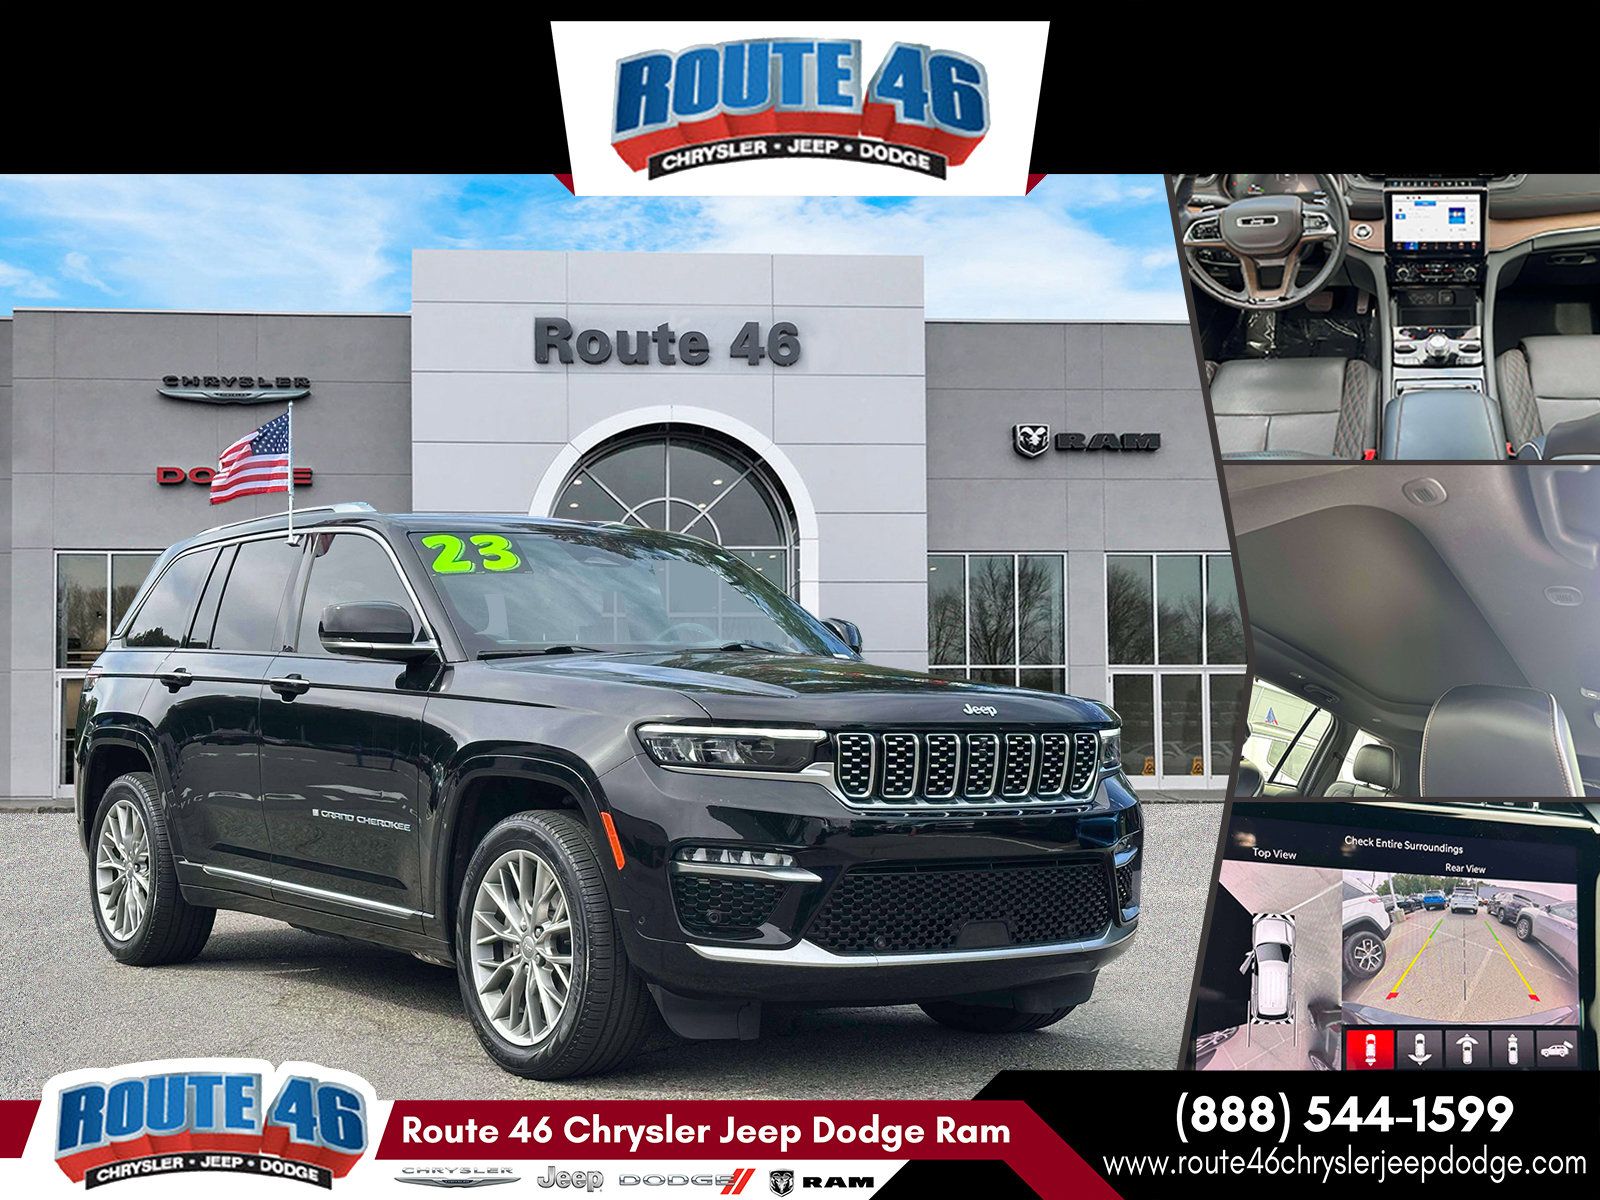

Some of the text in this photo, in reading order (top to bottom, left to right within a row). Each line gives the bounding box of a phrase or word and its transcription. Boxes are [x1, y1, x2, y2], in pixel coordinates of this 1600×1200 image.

[535, 317, 801, 367] Route 46
[162, 375, 311, 388] CHRYSLER
[1055, 432, 1161, 451] RAM
[156, 466, 313, 486] DOE
[421, 534, 521, 573] 23
[963, 703, 998, 717] Jeep
[320, 810, 355, 822] GRAND
[356, 816, 411, 832] CHEROKEE
[1253, 847, 1297, 861] Top View
[1344, 835, 1464, 855] Check Entire Surroundings
[1445, 862, 1486, 875] Rear View
